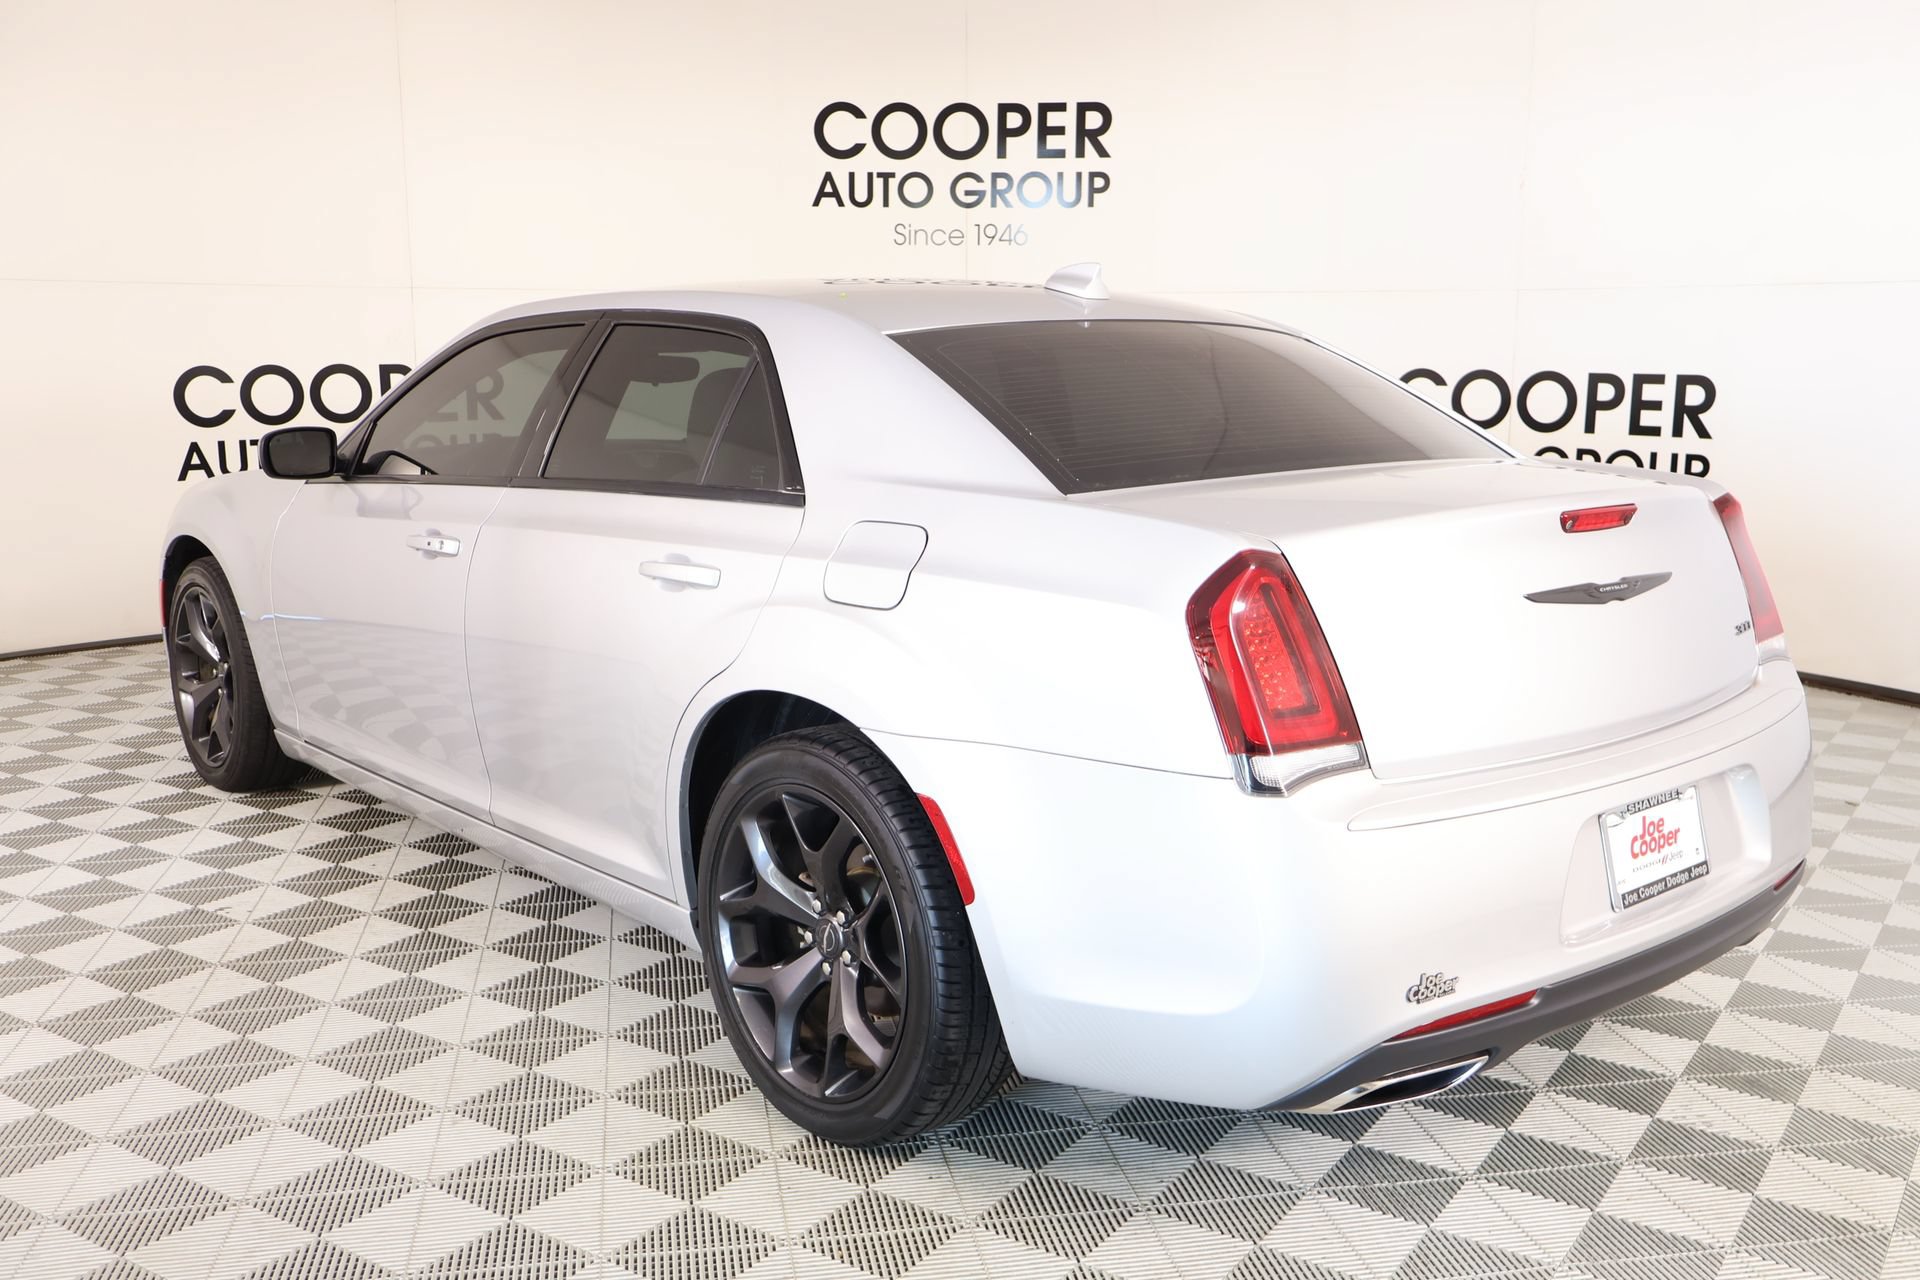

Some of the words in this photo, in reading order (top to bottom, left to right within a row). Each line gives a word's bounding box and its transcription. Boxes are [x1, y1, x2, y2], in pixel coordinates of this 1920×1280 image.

[813, 101, 1112, 160] COOPER
[811, 171, 934, 208] AUTO
[949, 171, 1110, 208] GROUP
[893, 223, 965, 246] Since
[974, 223, 1028, 246] 1946
[1599, 584, 1628, 592] CHRYSLER
[1627, 789, 1679, 814] SHAWNEE
[1639, 815, 1665, 840] Joe
[1631, 827, 1680, 859] Cooper
[1623, 893, 1638, 905] Joe
[1639, 881, 1665, 898] Cooper
[1666, 872, 1690, 888] Dodge
[1690, 864, 1708, 878] Jeep
[1406, 976, 1459, 1003] Cooper
[1419, 972, 1444, 989] Joe
